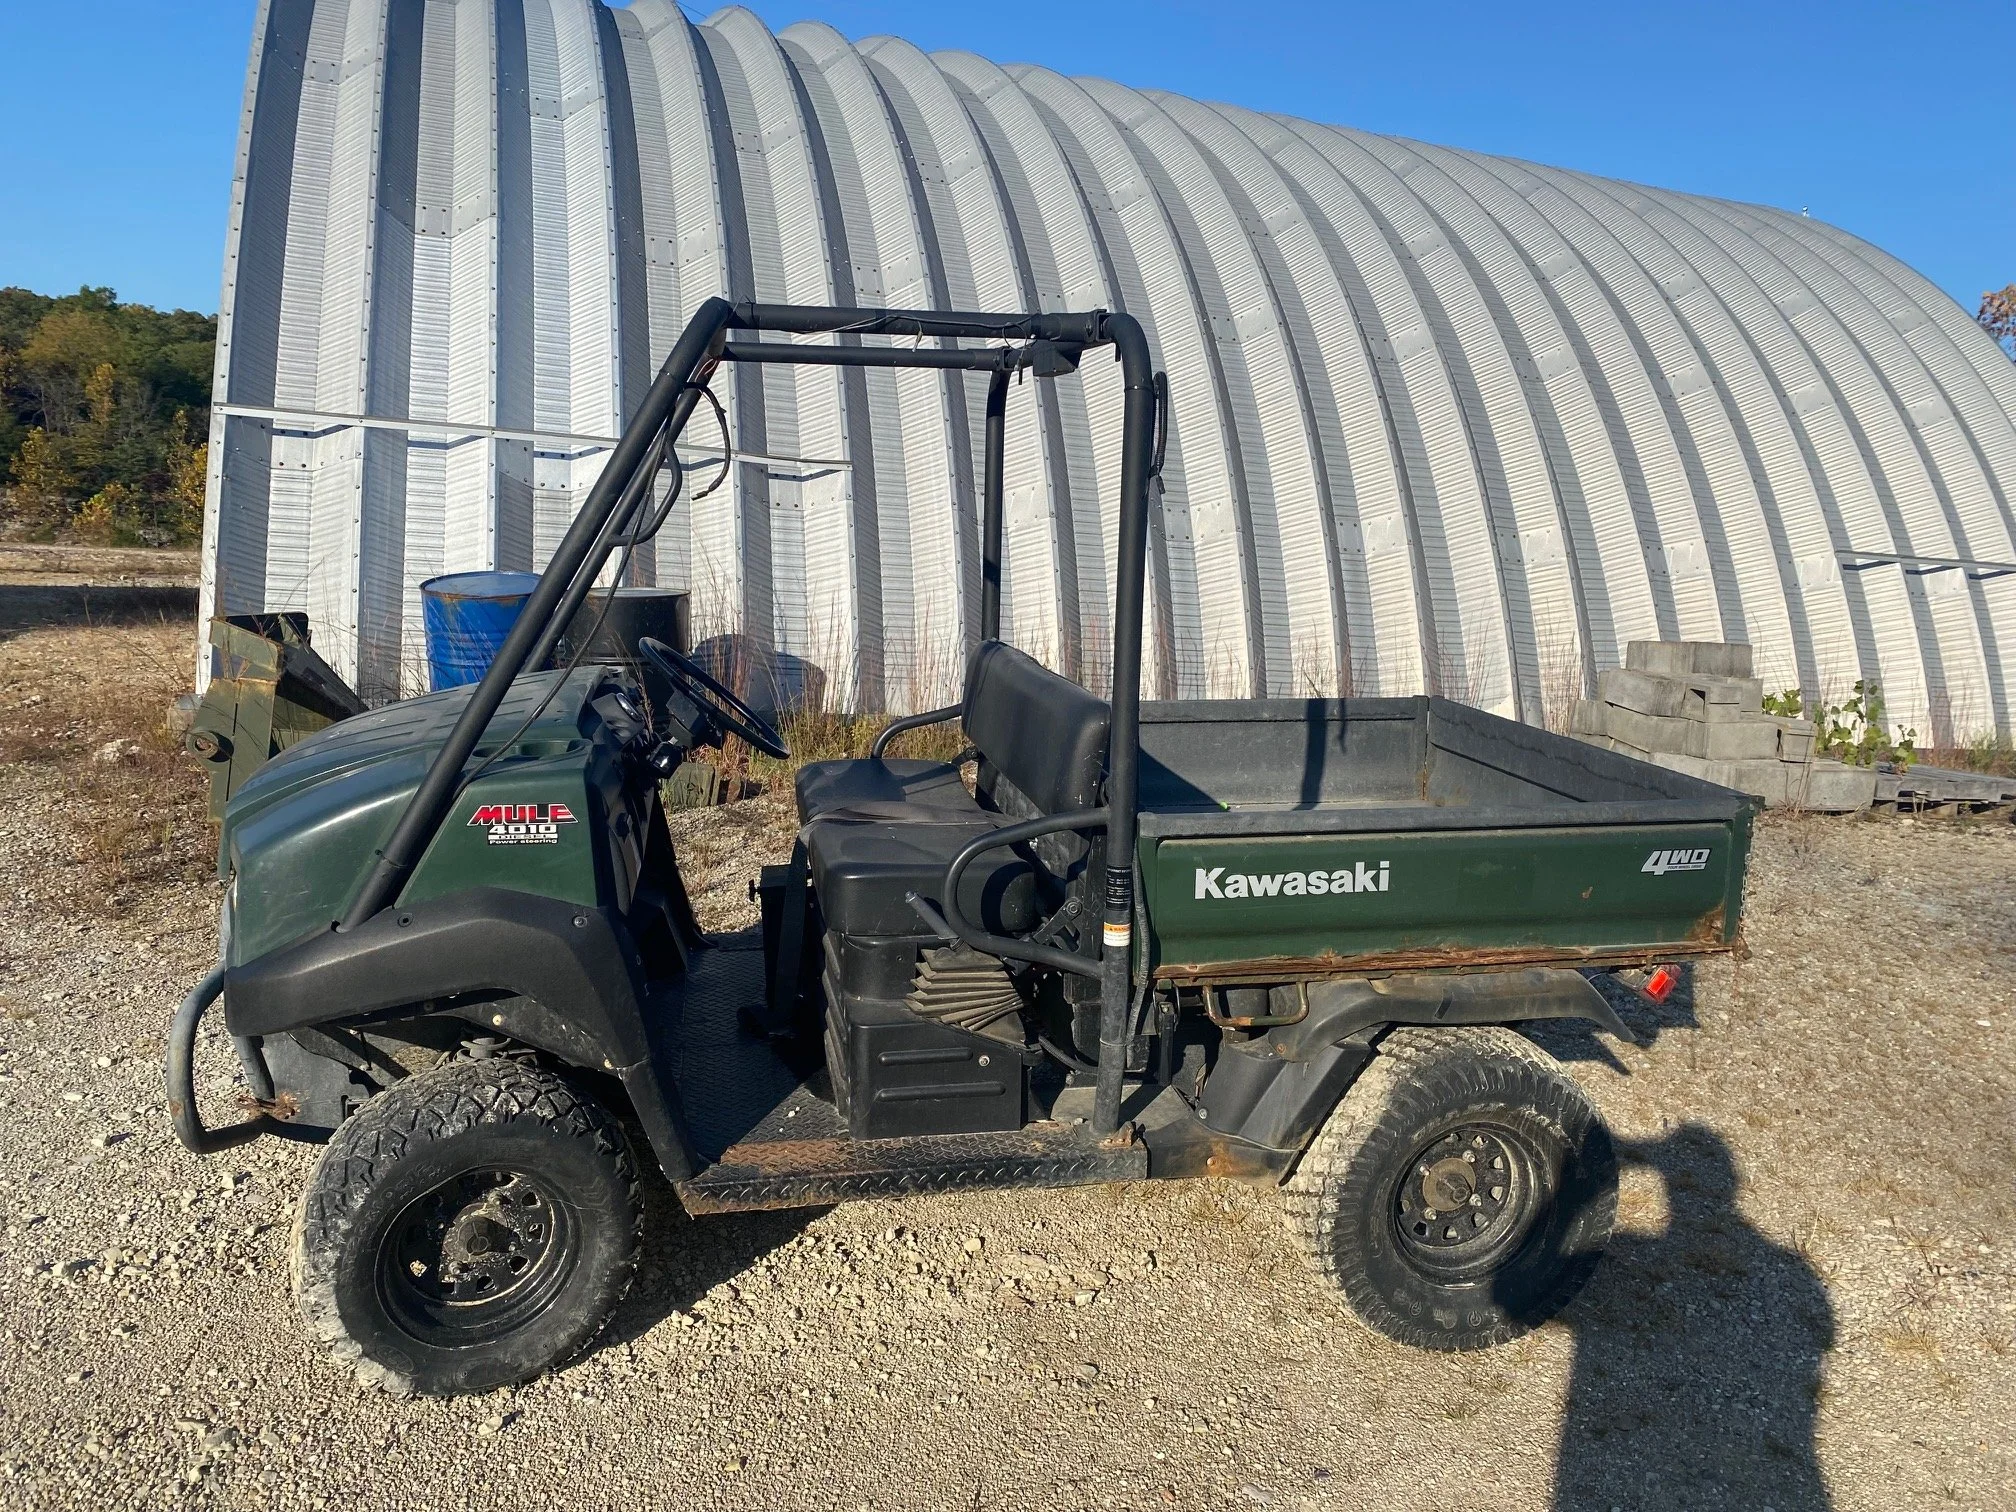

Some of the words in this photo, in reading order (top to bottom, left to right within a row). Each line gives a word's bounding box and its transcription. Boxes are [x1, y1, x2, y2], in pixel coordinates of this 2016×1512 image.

[466, 804, 579, 826] MULE
[488, 825, 557, 834] 4010
[1641, 849, 1710, 875] 4WD
[1194, 860, 1391, 899] Kawasaki
